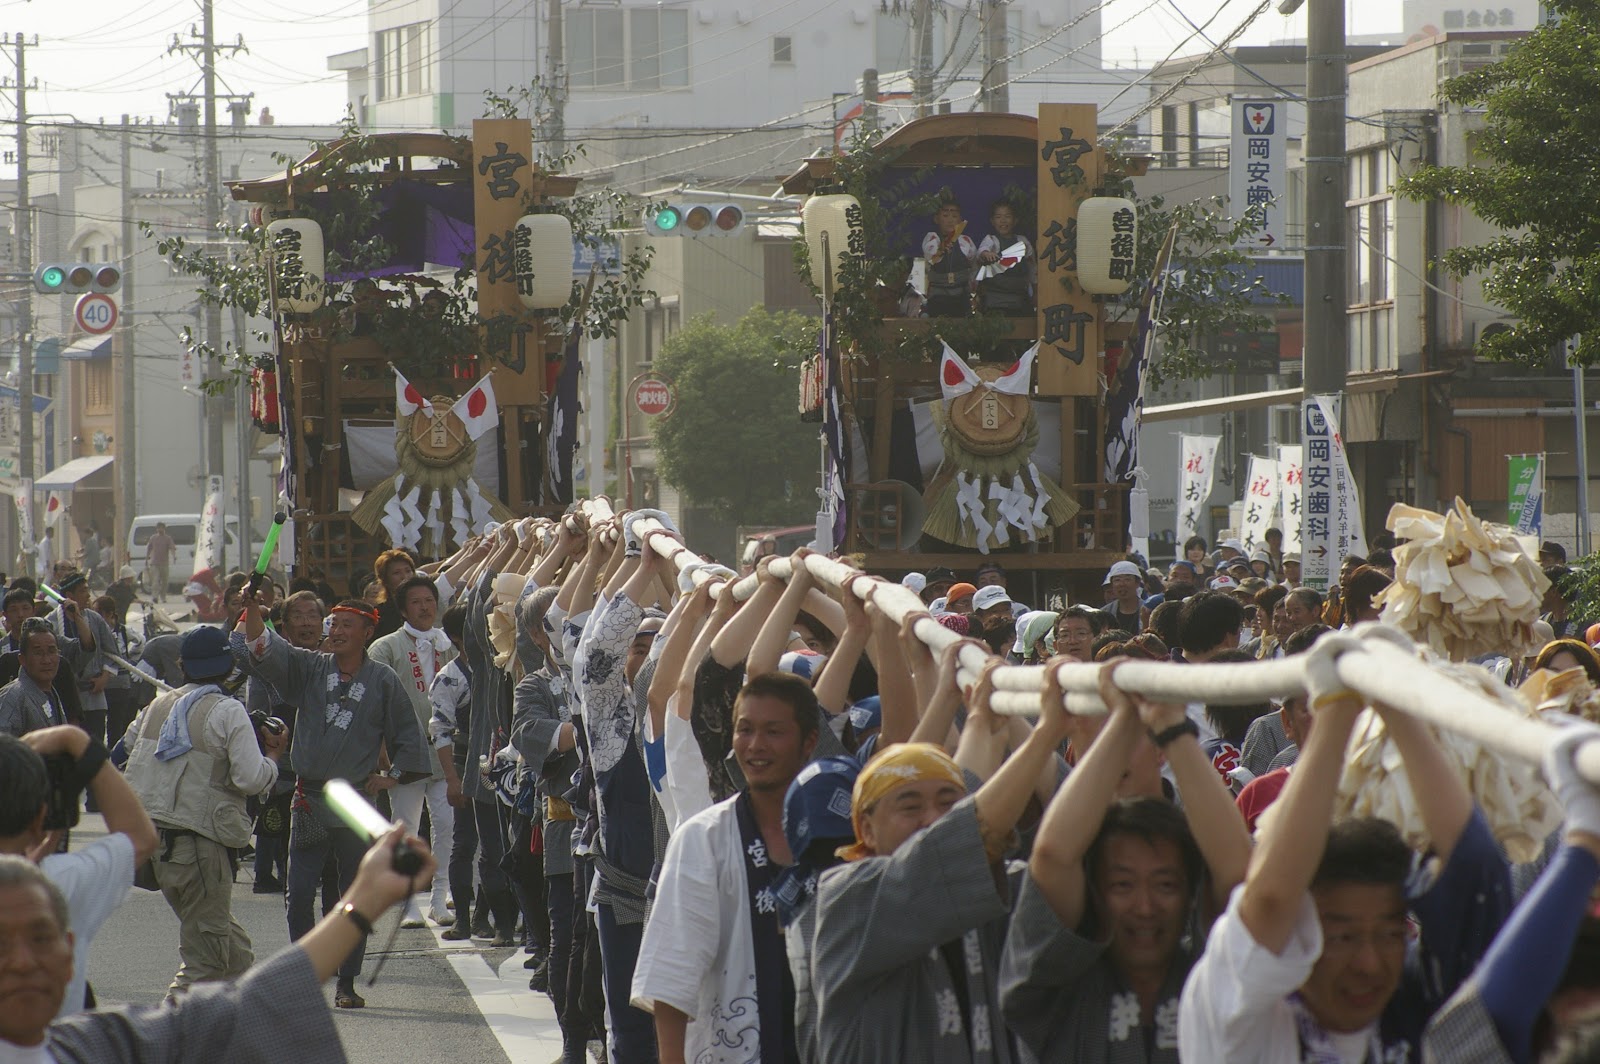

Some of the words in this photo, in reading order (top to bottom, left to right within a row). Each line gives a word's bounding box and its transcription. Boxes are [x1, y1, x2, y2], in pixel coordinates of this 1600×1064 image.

[478, 142, 533, 374] 宮後町
[514, 224, 535, 297] 宮後町
[572, 244, 616, 265] 進学
[1040, 128, 1094, 366] 宮後町
[1109, 208, 1135, 283] 宮後町
[84, 304, 109, 323] 40
[638, 392, 667, 405] 消火栓
[1307, 439, 1330, 541] 岡安歯科
[748, 838, 776, 915] 宮後
